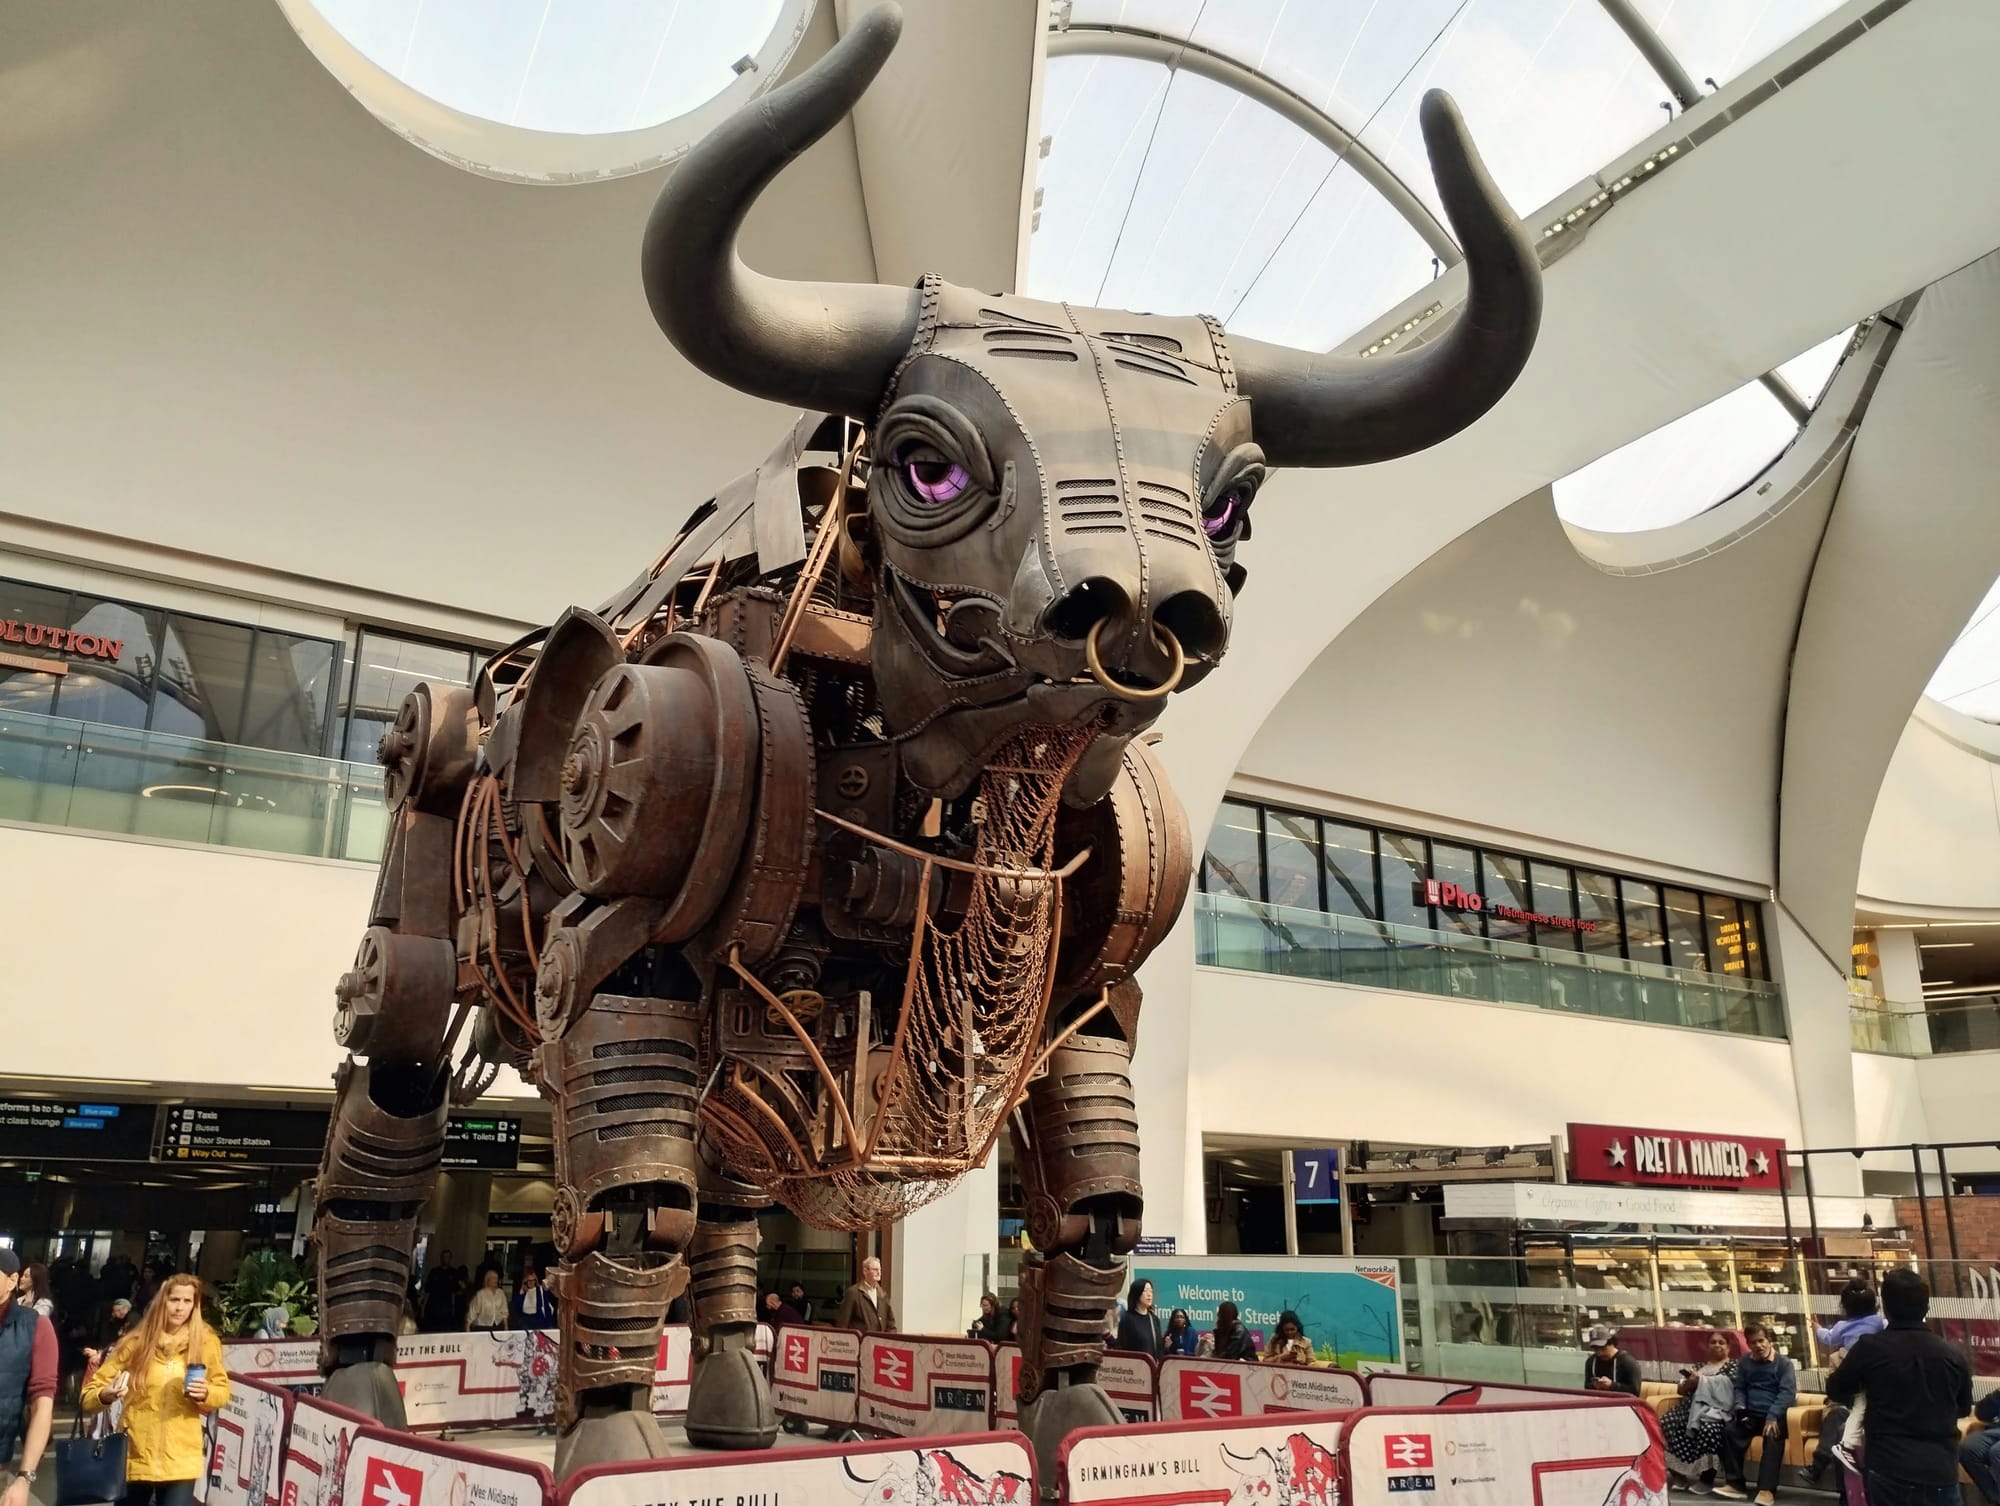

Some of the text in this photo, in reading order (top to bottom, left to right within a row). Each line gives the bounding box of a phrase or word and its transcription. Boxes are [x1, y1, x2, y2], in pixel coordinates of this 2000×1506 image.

[0, 618, 123, 660] LUTION
[1441, 881, 1482, 911] Pho
[1497, 904, 1597, 932] Vietnamese street food
[7, 1117, 29, 1125] class
[31, 1117, 60, 1128] lounge
[197, 1111, 218, 1120] Taxis
[195, 1123, 219, 1132] Buses
[473, 1132, 495, 1140] Toilets
[193, 1136, 271, 1146] Moor Street Station
[192, 1150, 209, 1158] Way
[211, 1150, 227, 1158] Out
[1633, 1135, 1749, 1178] PRET A MANGER
[1304, 1160, 1319, 1188] 7
[1178, 1284, 1245, 1302] Welcome to
[1245, 1308, 1281, 1325] Street
[420, 1345, 435, 1355] THE
[440, 1344, 461, 1353] BULL
[1291, 1380, 1338, 1393] West Midlands
[1291, 1389, 1354, 1406] Combined Authority
[1080, 1459, 1200, 1482] BIRMINGHAM'S BULL
